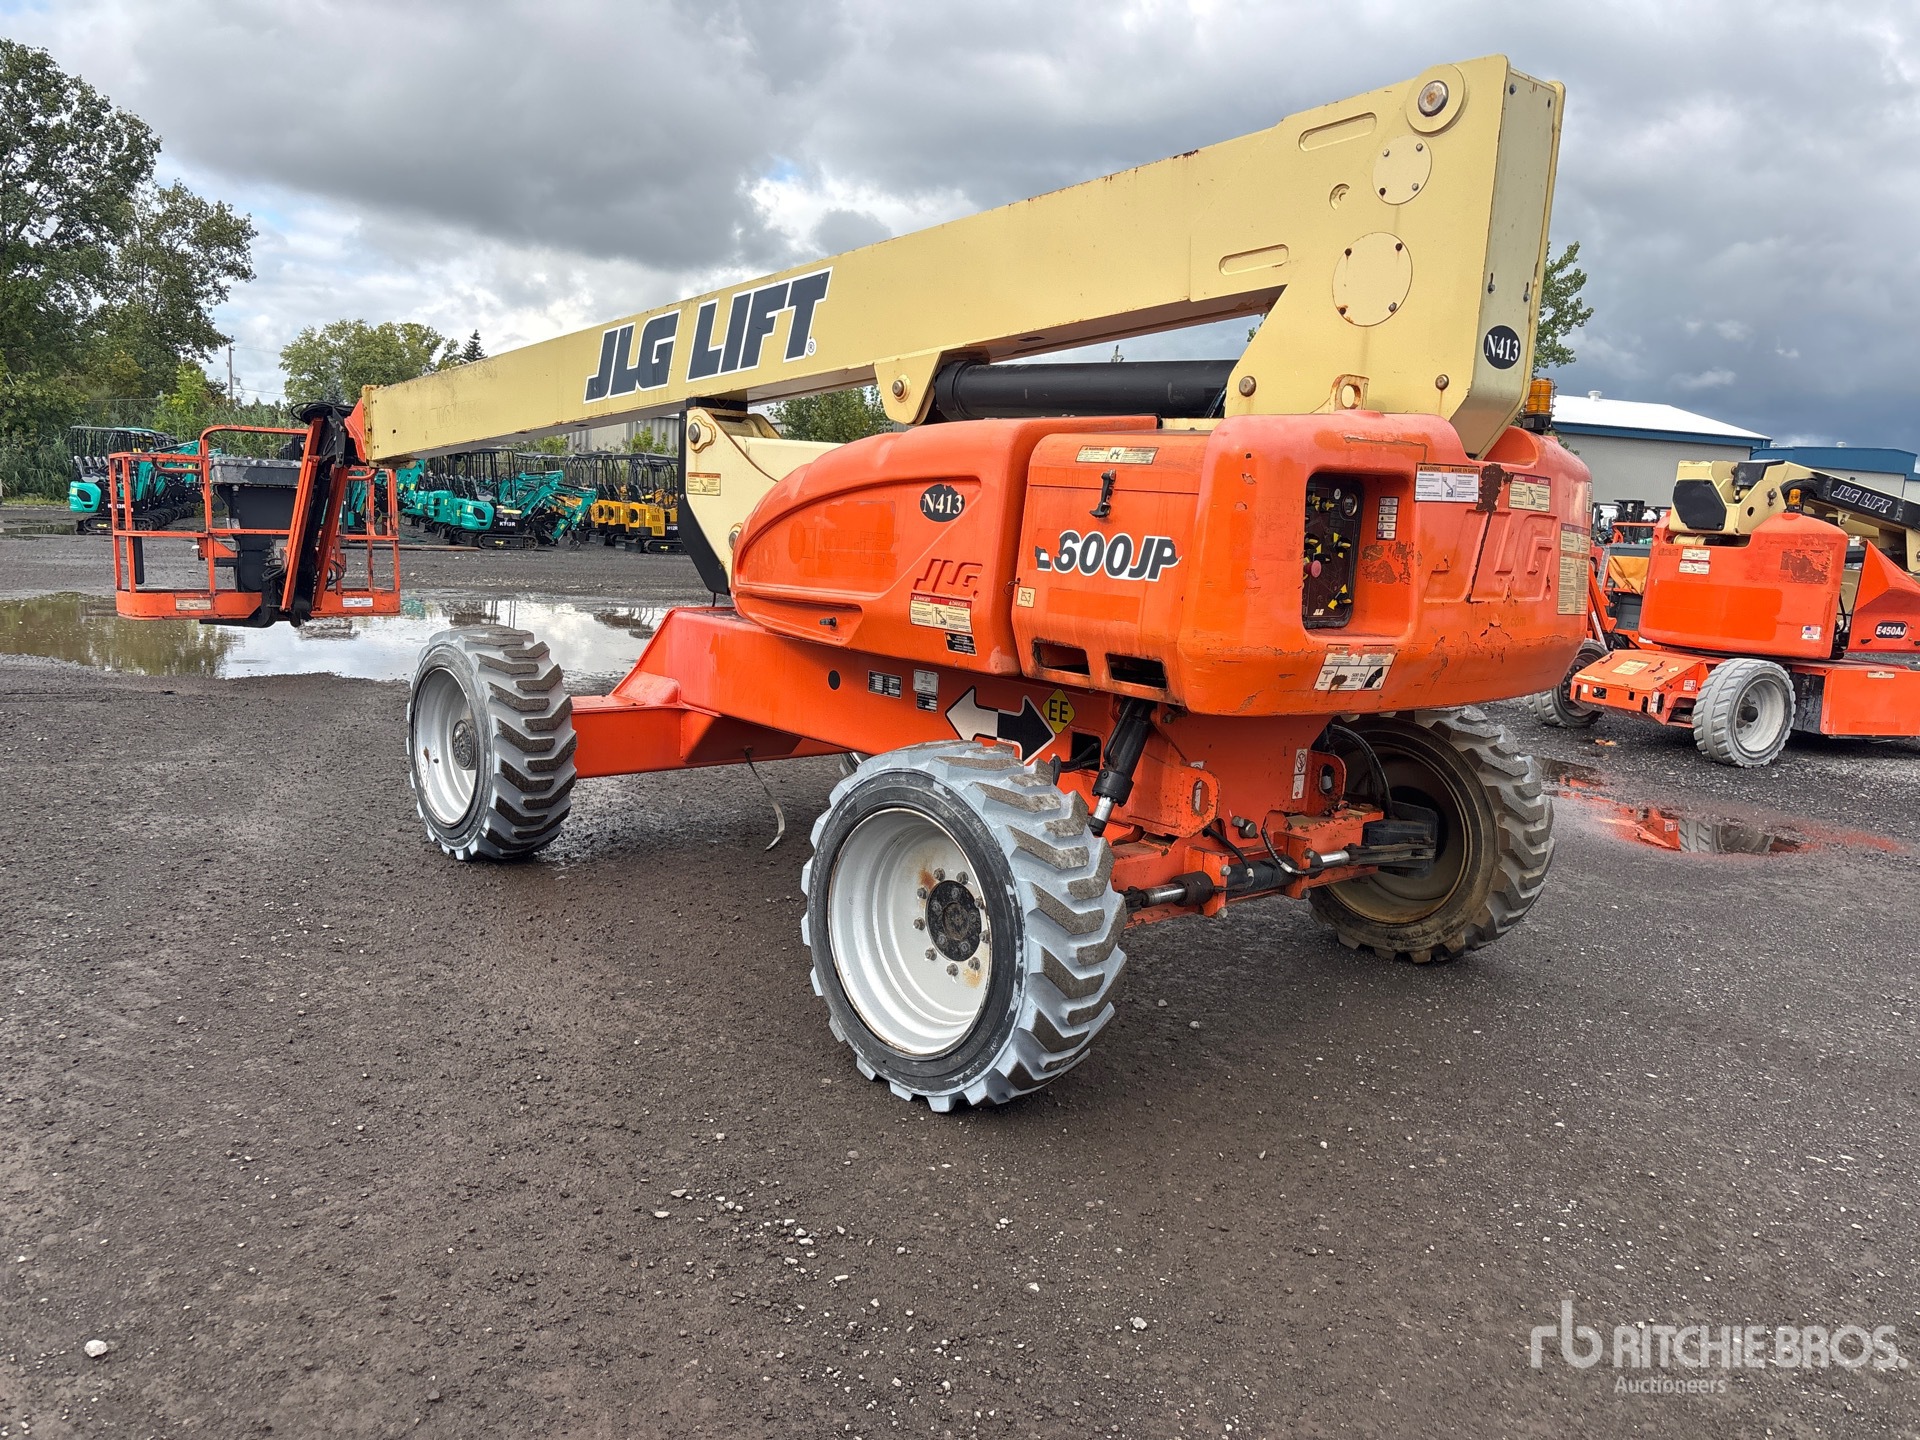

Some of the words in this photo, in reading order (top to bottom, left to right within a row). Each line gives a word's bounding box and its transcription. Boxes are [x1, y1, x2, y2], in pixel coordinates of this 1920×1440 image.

[584, 308, 682, 405] JLG
[686, 266, 833, 383] LIFT
[1485, 334, 1520, 362] N413
[922, 493, 963, 515] N413
[1831, 484, 1862, 504] JLG
[1858, 492, 1893, 514] LIFT
[1876, 625, 1907, 636] E450AJ
[1048, 698, 1069, 724] EE
